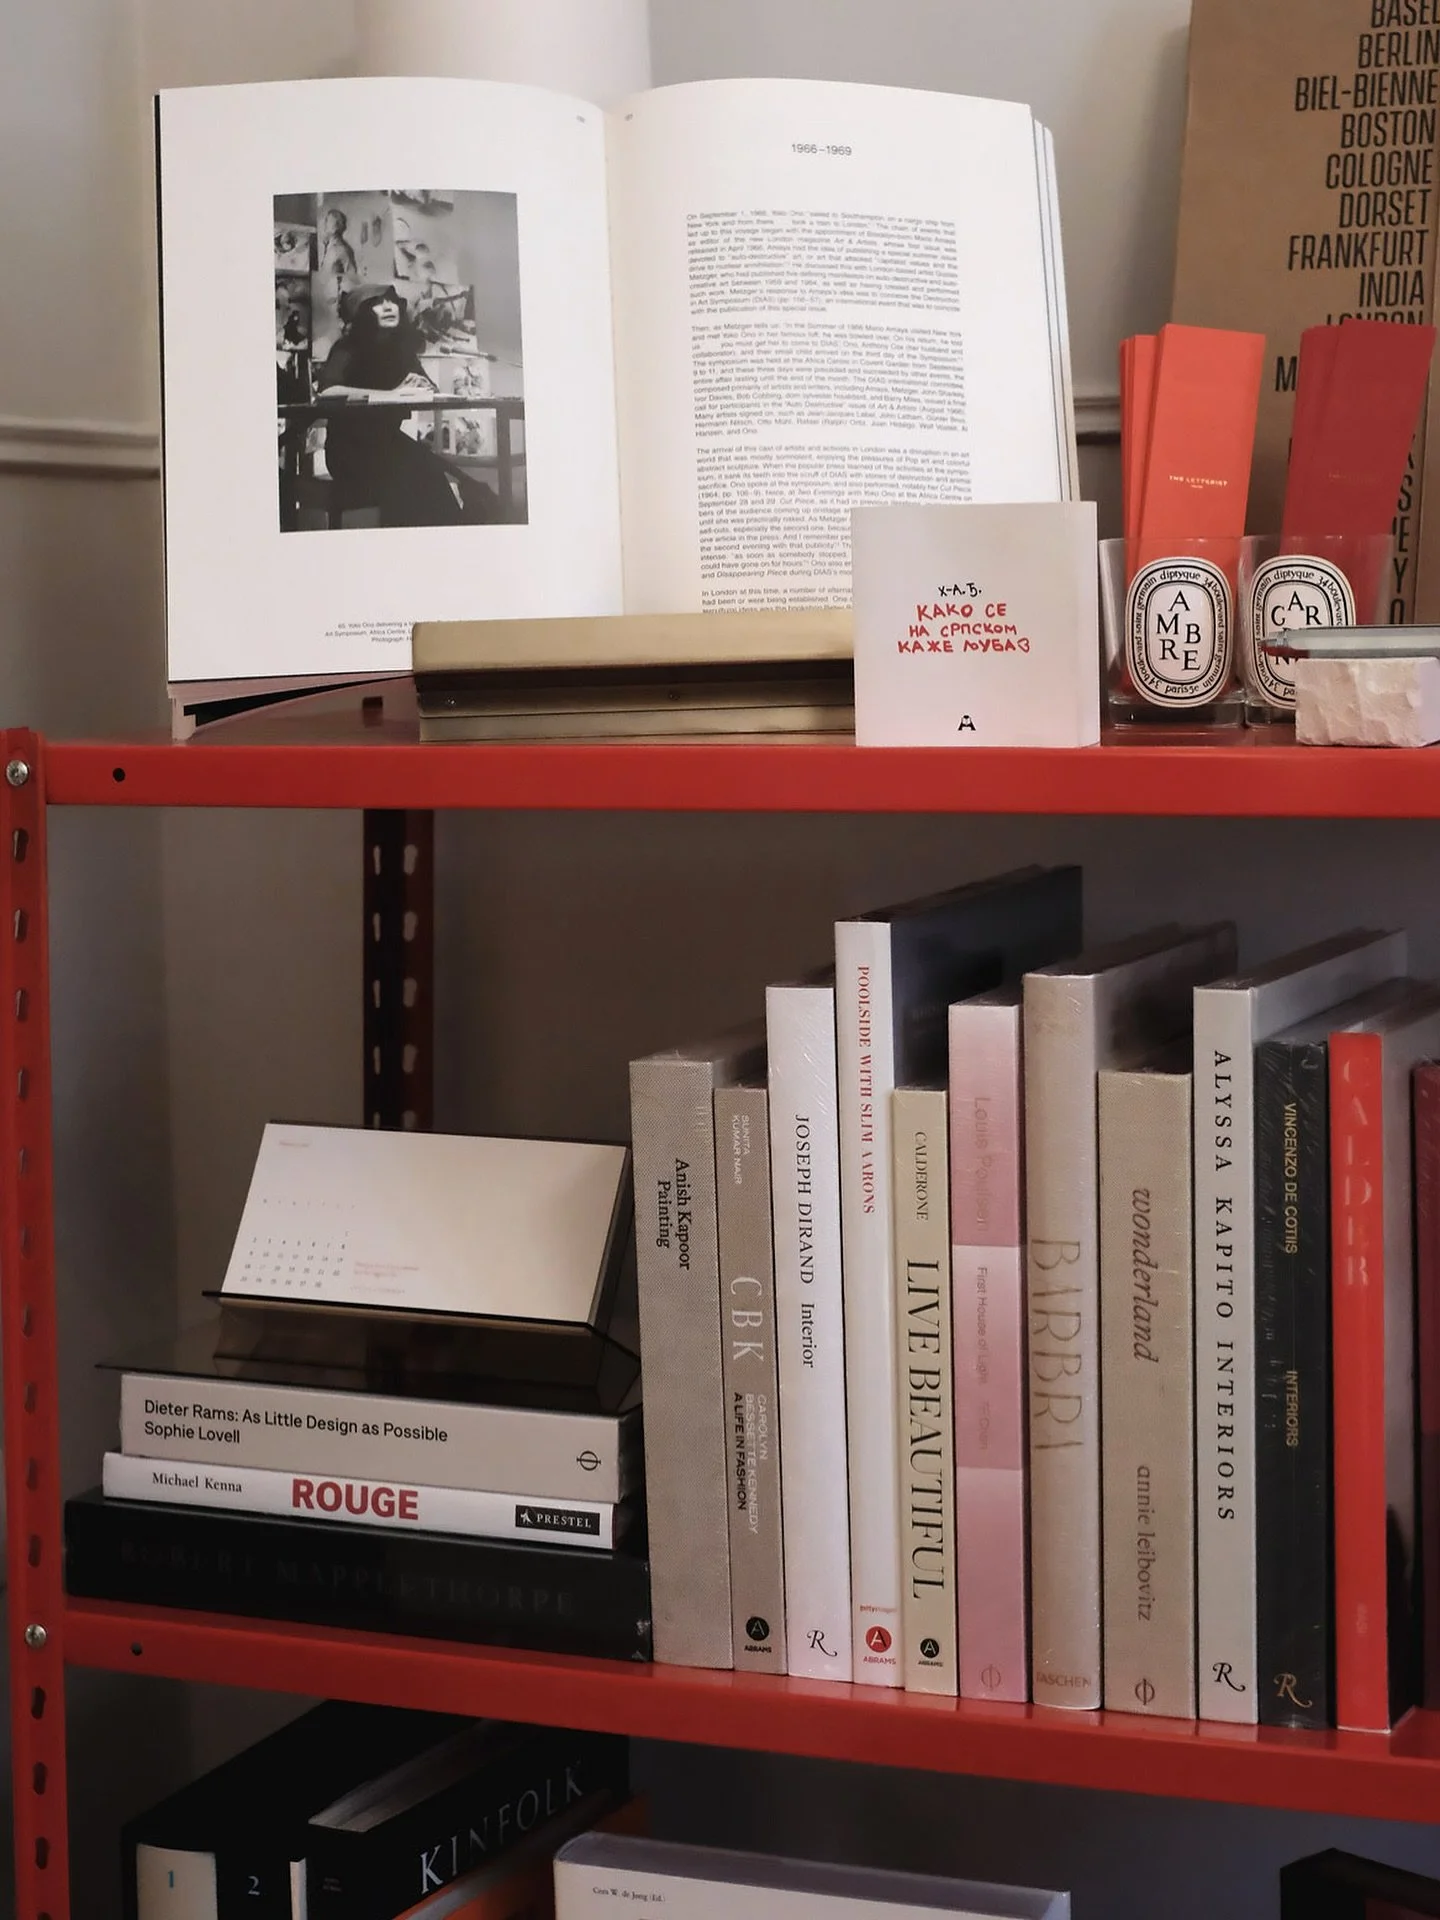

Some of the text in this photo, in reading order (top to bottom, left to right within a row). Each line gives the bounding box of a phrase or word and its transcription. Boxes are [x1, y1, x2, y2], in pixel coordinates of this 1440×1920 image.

[1358, 29, 1440, 68] BERLIN
[1295, 69, 1438, 112] BIEL-BIENNE
[1341, 109, 1436, 149] BOSTON
[1326, 149, 1434, 190] COLOGNE
[1339, 189, 1432, 228] DORSET
[1288, 229, 1429, 271] FRANKFURT
[1359, 270, 1425, 308] INDIA
[1160, 570, 1201, 580] diptyque
[1274, 570, 1315, 580] diptyque
[909, 625, 930, 638] НА
[917, 603, 1007, 621] КАКО СЕ
[898, 641, 954, 654] КАЖЕ
[857, 966, 875, 1214] POOLSIDE WITH SLIM AARONS
[741, 1115, 750, 1155] SUNITA
[1284, 1103, 1297, 1178] VINCENZO
[915, 1131, 928, 1221] CALDERONE
[1285, 1183, 1297, 1202] DE
[656, 1180, 674, 1248] Painting
[675, 1158, 692, 1270] Anish Kapoor
[795, 1115, 817, 1368] JOSEPH DIRAND Interior
[1215, 1051, 1234, 1520] ALYSSA KAPITO INTERIORS
[144, 1400, 448, 1443] Dieter Rams: As Little Design as Possible
[1132, 1188, 1159, 1621] wonderland annie leibovitz
[1286, 1370, 1298, 1447] INTERIORS
[144, 1422, 241, 1444] Sophie Lovell
[757, 1394, 768, 1460] CAROLYN
[907, 1260, 945, 1599] LIVE BEAUTIFUL
[734, 1392, 746, 1510] A LIFE IN FASHION
[152, 1472, 242, 1493] Michael Kenna
[292, 1478, 418, 1521] ROUGE
[537, 1513, 592, 1528] PRESTEL
[806, 1629, 837, 1657] R
[863, 1656, 896, 1665] ABRAMS
[1212, 1662, 1246, 1692] R
[1273, 1672, 1312, 1708] R
[420, 1766, 584, 1895] KINFOLK
[166, 1870, 176, 1889] 1
[247, 1876, 261, 1896] 2
